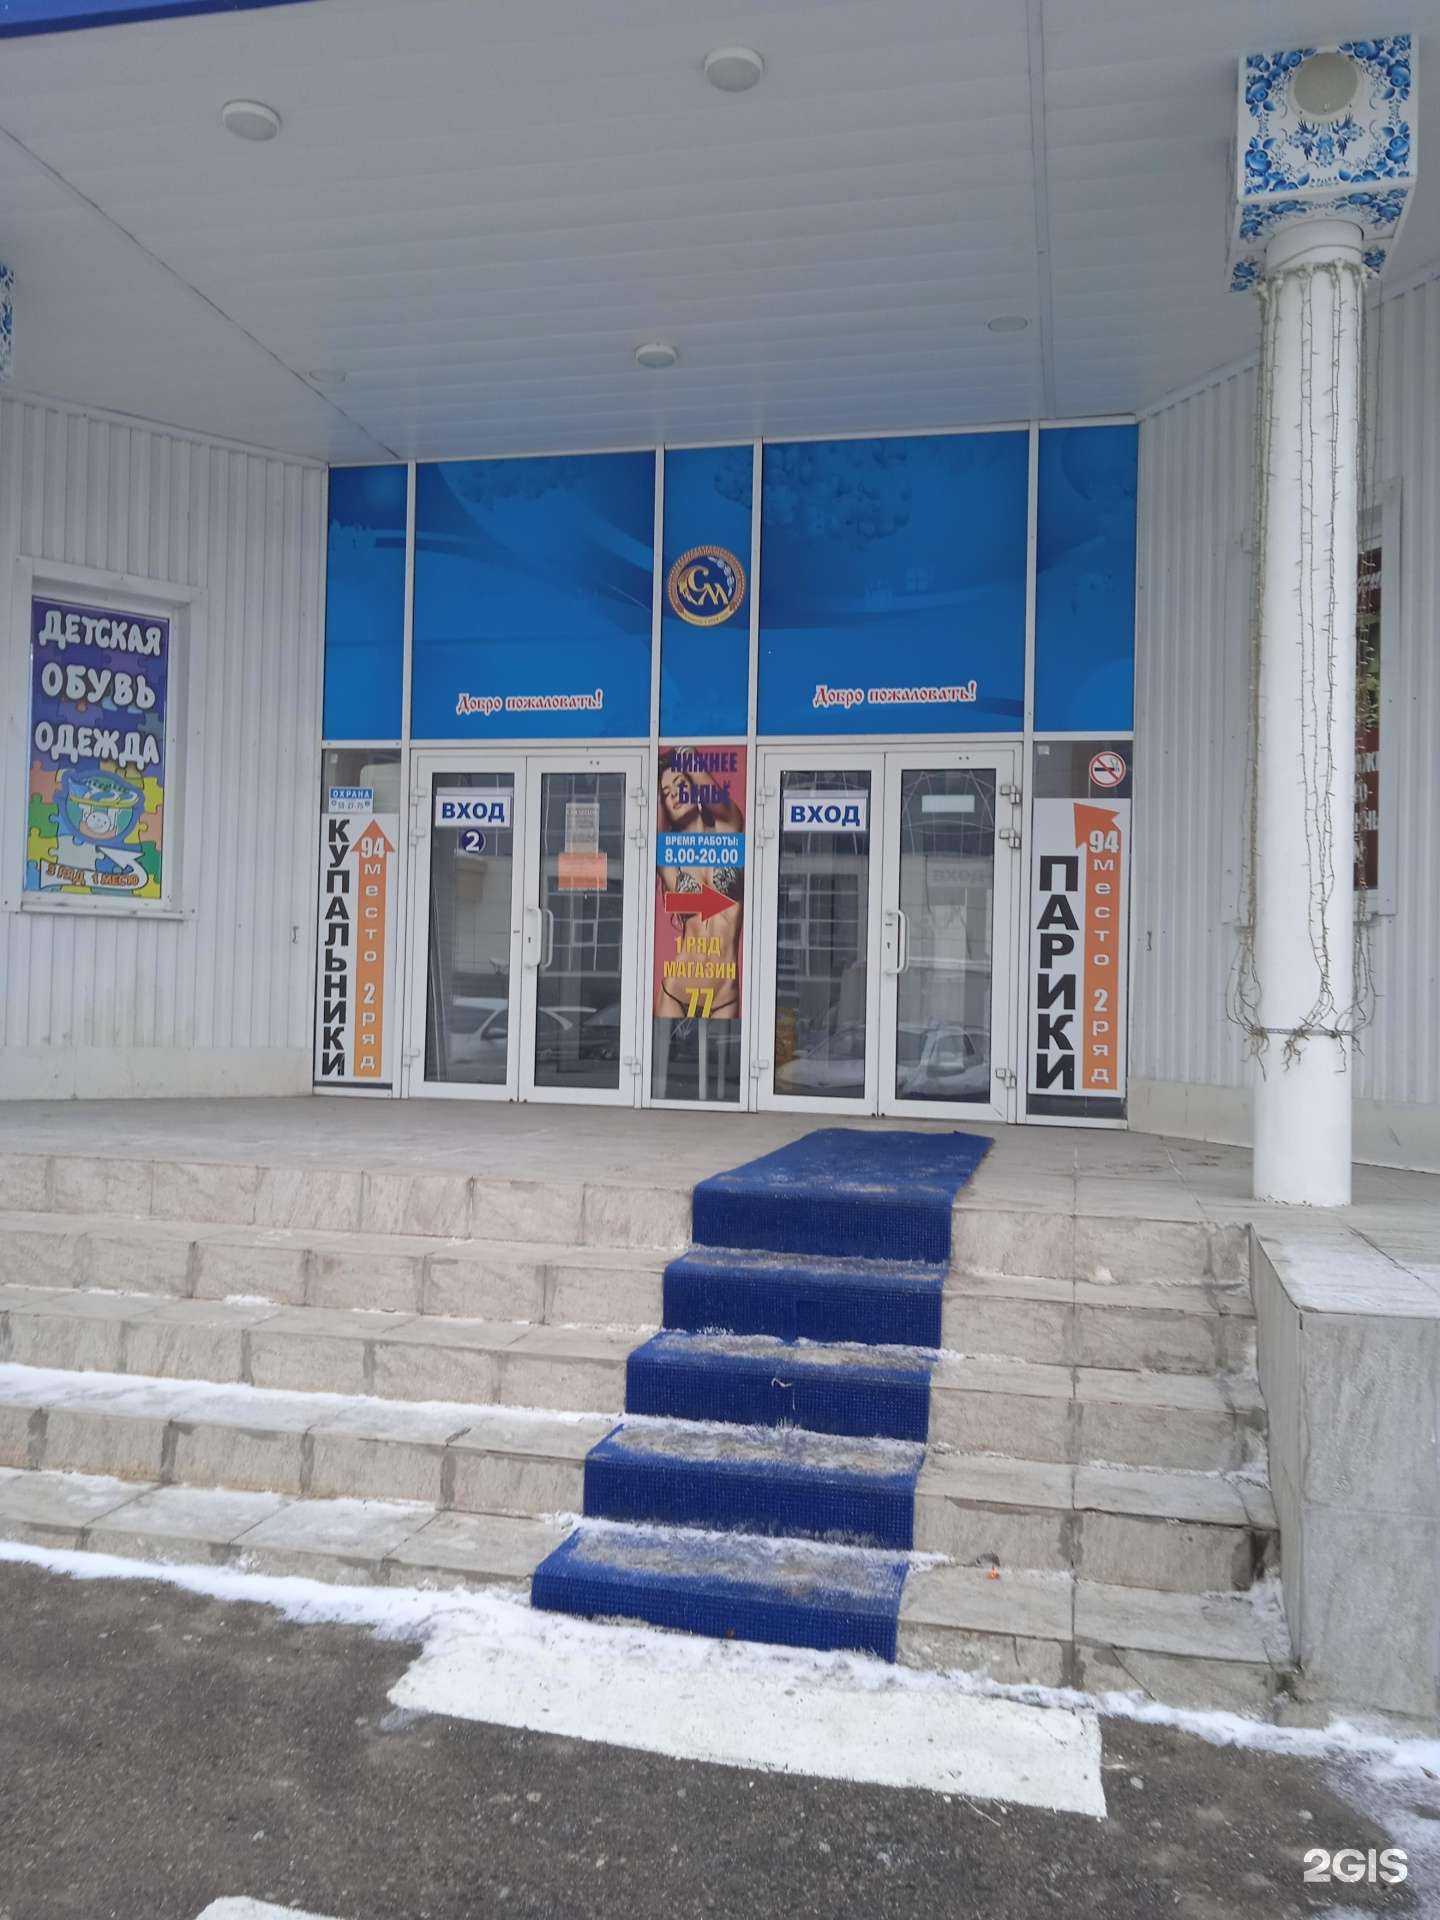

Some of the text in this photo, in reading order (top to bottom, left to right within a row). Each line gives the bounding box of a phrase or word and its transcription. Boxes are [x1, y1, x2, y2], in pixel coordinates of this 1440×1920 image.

[38, 610, 162, 656] ДЕТСКАЯ
[41, 662, 156, 710] ОБУВЬ
[813, 680, 977, 708] Добро пожаловать!
[456, 688, 603, 716] Добро пожаловать!
[35, 721, 160, 771] ОДЕЖДА
[670, 752, 738, 773] НИЖНЕЕ
[332, 790, 370, 799] ОХРАНА
[441, 802, 505, 822] ВХОД
[790, 805, 861, 827] ВХОД
[361, 837, 385, 858] 94
[464, 831, 480, 851] 2
[665, 835, 739, 847] ВРЕМЯ РАБОТЫ:
[1088, 830, 1119, 853] 94
[664, 848, 739, 864] 8.00-20.00
[321, 819, 350, 1077] КУПАЛЬНИКИ
[686, 936, 722, 955] РЯД
[663, 960, 737, 980] МАГАЗИН
[1036, 855, 1080, 1091] ПАРИКИ
[363, 983, 376, 1005] 2
[685, 987, 714, 1018] 77
[1093, 988, 1108, 1013] 2
[359, 1012, 376, 1071] ряд
[1091, 1020, 1110, 1083] ряд
